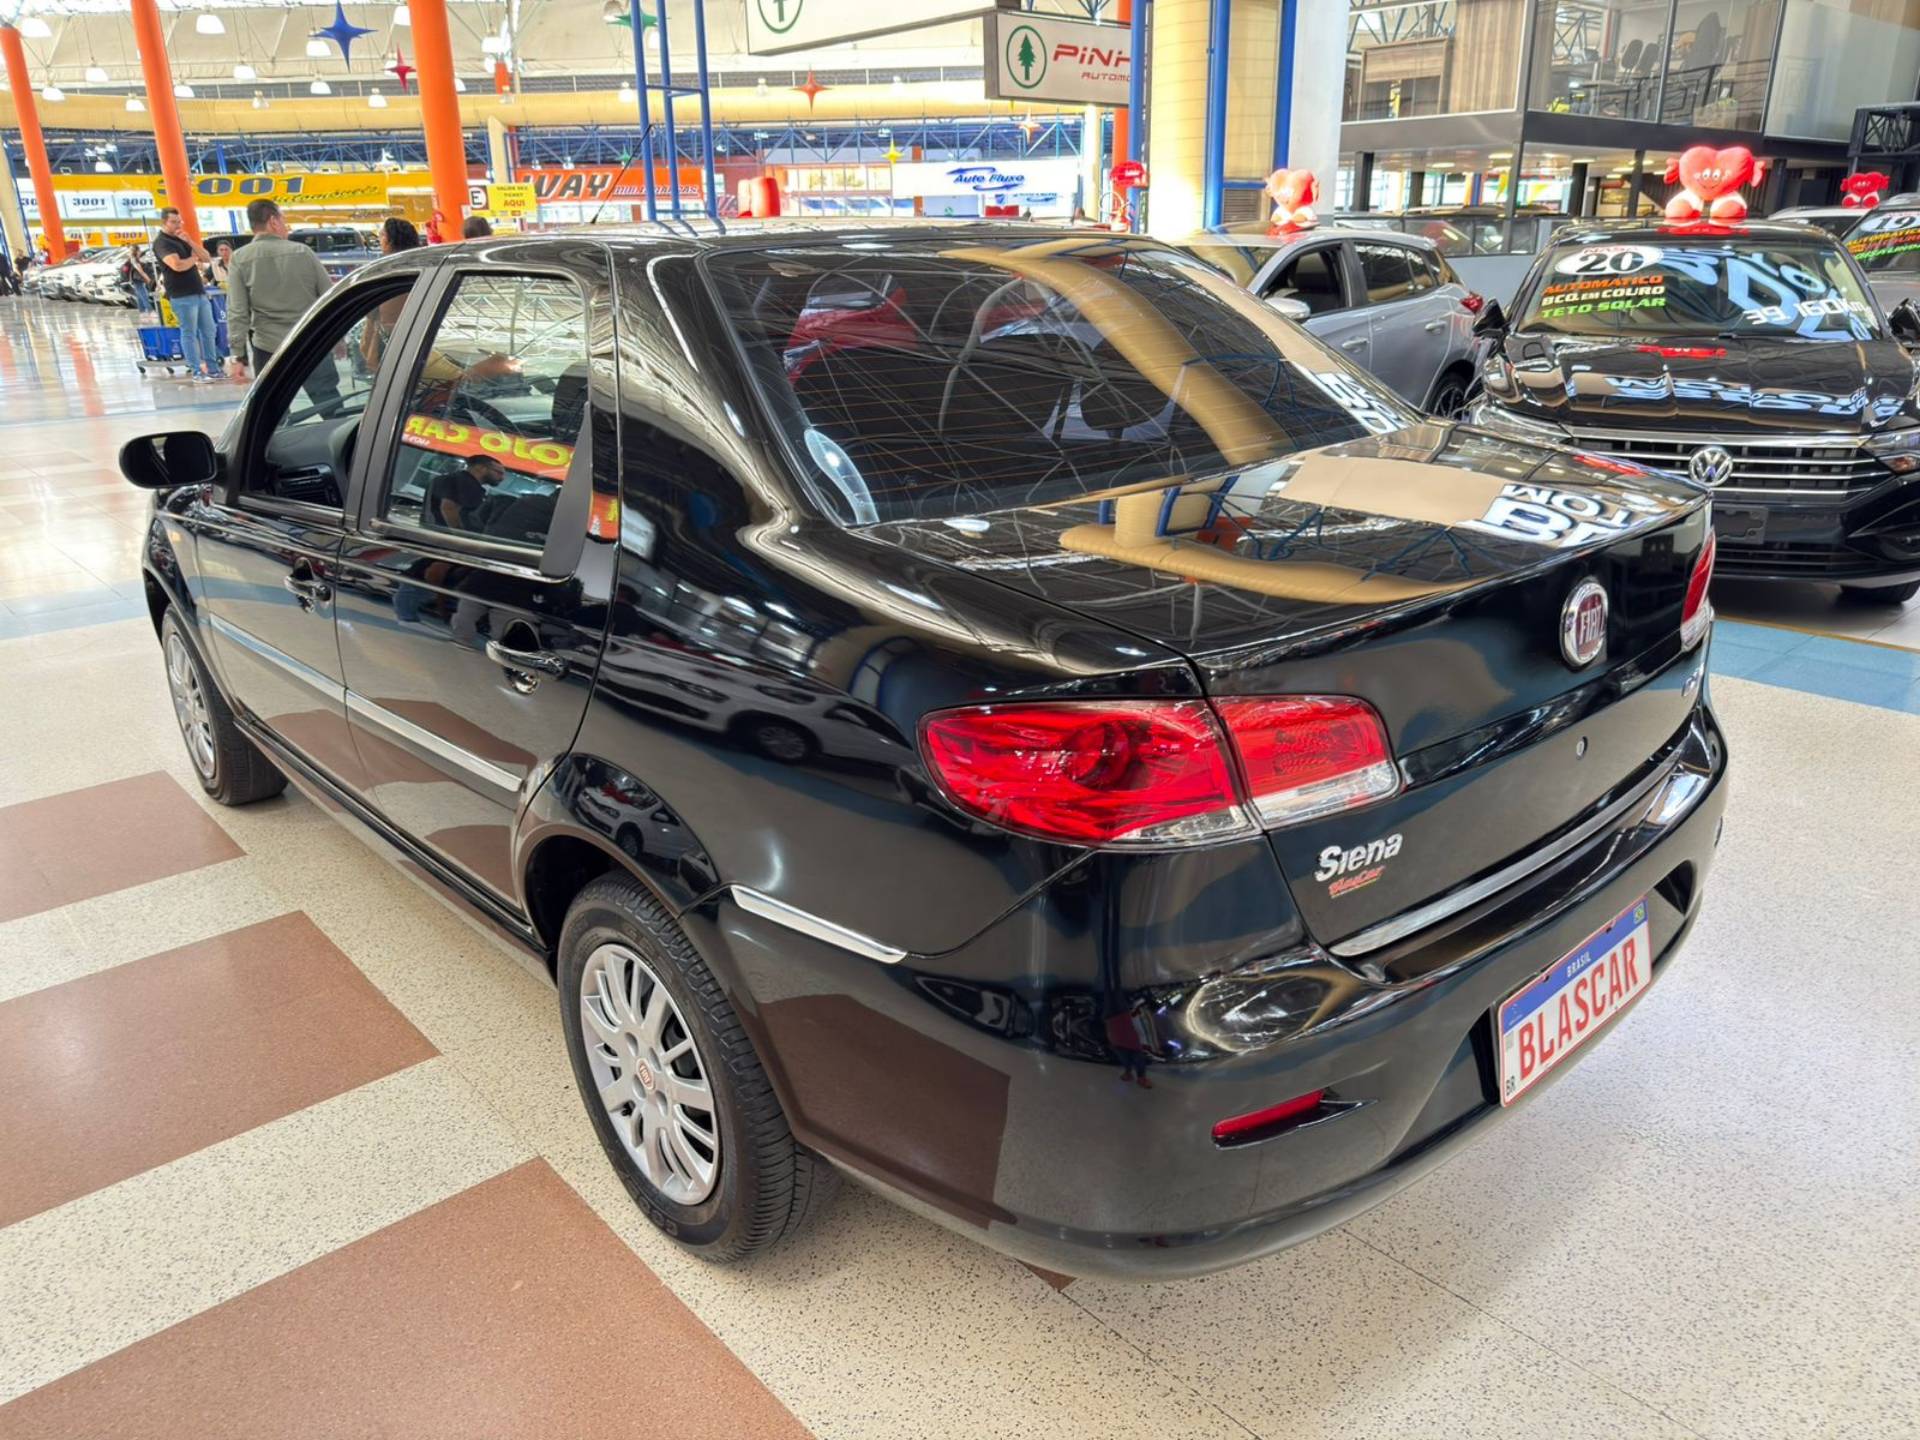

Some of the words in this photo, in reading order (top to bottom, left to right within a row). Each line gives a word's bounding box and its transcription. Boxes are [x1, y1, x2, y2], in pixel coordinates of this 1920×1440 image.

[953, 174, 986, 183] Auto
[72, 197, 105, 206] 3001
[121, 198, 153, 206] 3001
[471, 190, 483, 206] E
[1873, 215, 1916, 230] 19
[1575, 252, 1645, 273] 20
[1601, 286, 1666, 299] COURO
[1541, 303, 1593, 319] TETO
[1597, 297, 1667, 313] SOLAR
[1313, 832, 1404, 882] Siena
[1566, 951, 1592, 978] BRASIL
[1518, 937, 1638, 1081] BLASCAR
